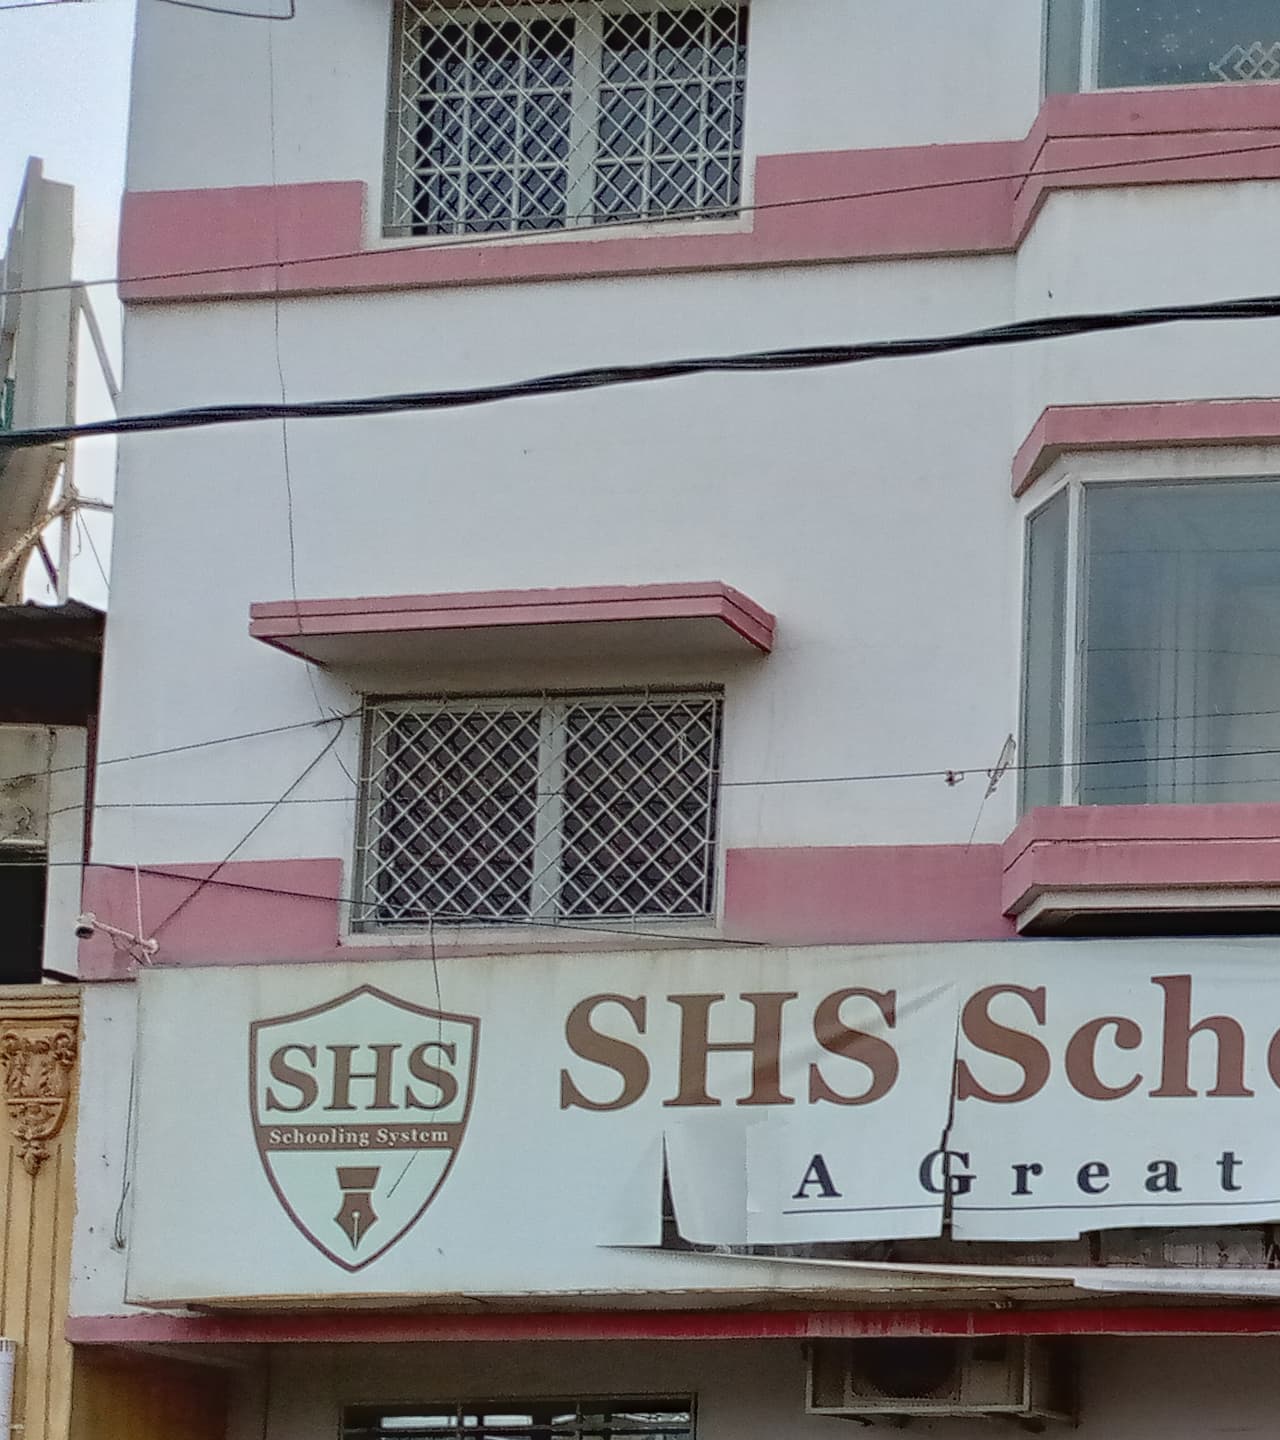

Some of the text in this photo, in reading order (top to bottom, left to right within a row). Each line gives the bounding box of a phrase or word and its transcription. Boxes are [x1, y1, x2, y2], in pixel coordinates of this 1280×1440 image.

[265, 1042, 459, 1112] SHS
[560, 987, 899, 1110] SHS
[269, 1127, 449, 1147] Schooling System
[791, 1153, 842, 1199] A
[918, 1149, 1243, 1198] Great
